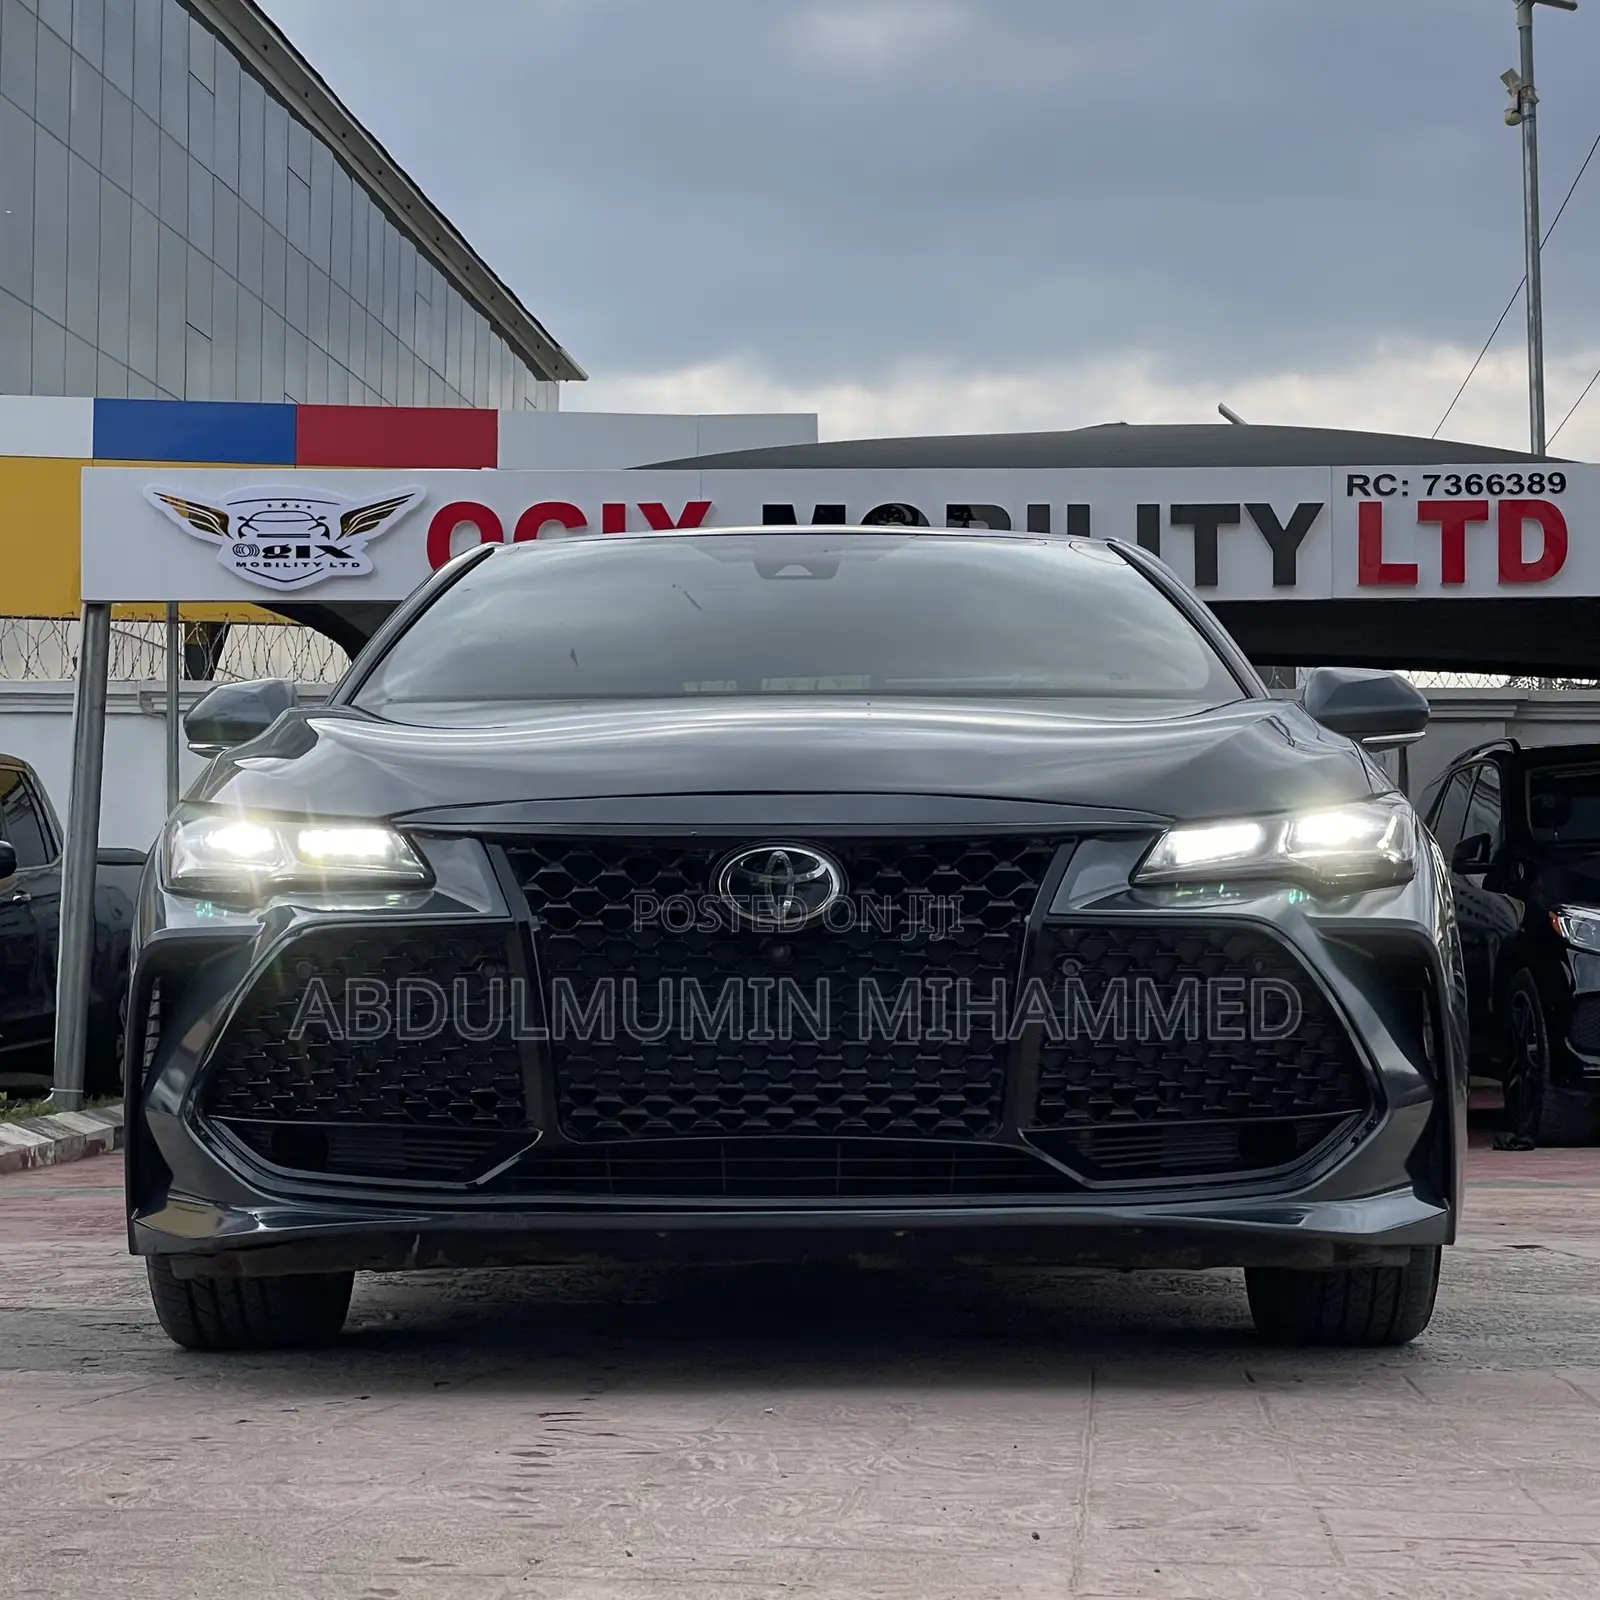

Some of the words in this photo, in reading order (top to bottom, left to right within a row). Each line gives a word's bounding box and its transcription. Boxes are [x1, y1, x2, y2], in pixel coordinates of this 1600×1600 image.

[1347, 474, 1408, 497] RC:
[1422, 472, 1567, 496] 7366389
[1358, 499, 1568, 586] LTD
